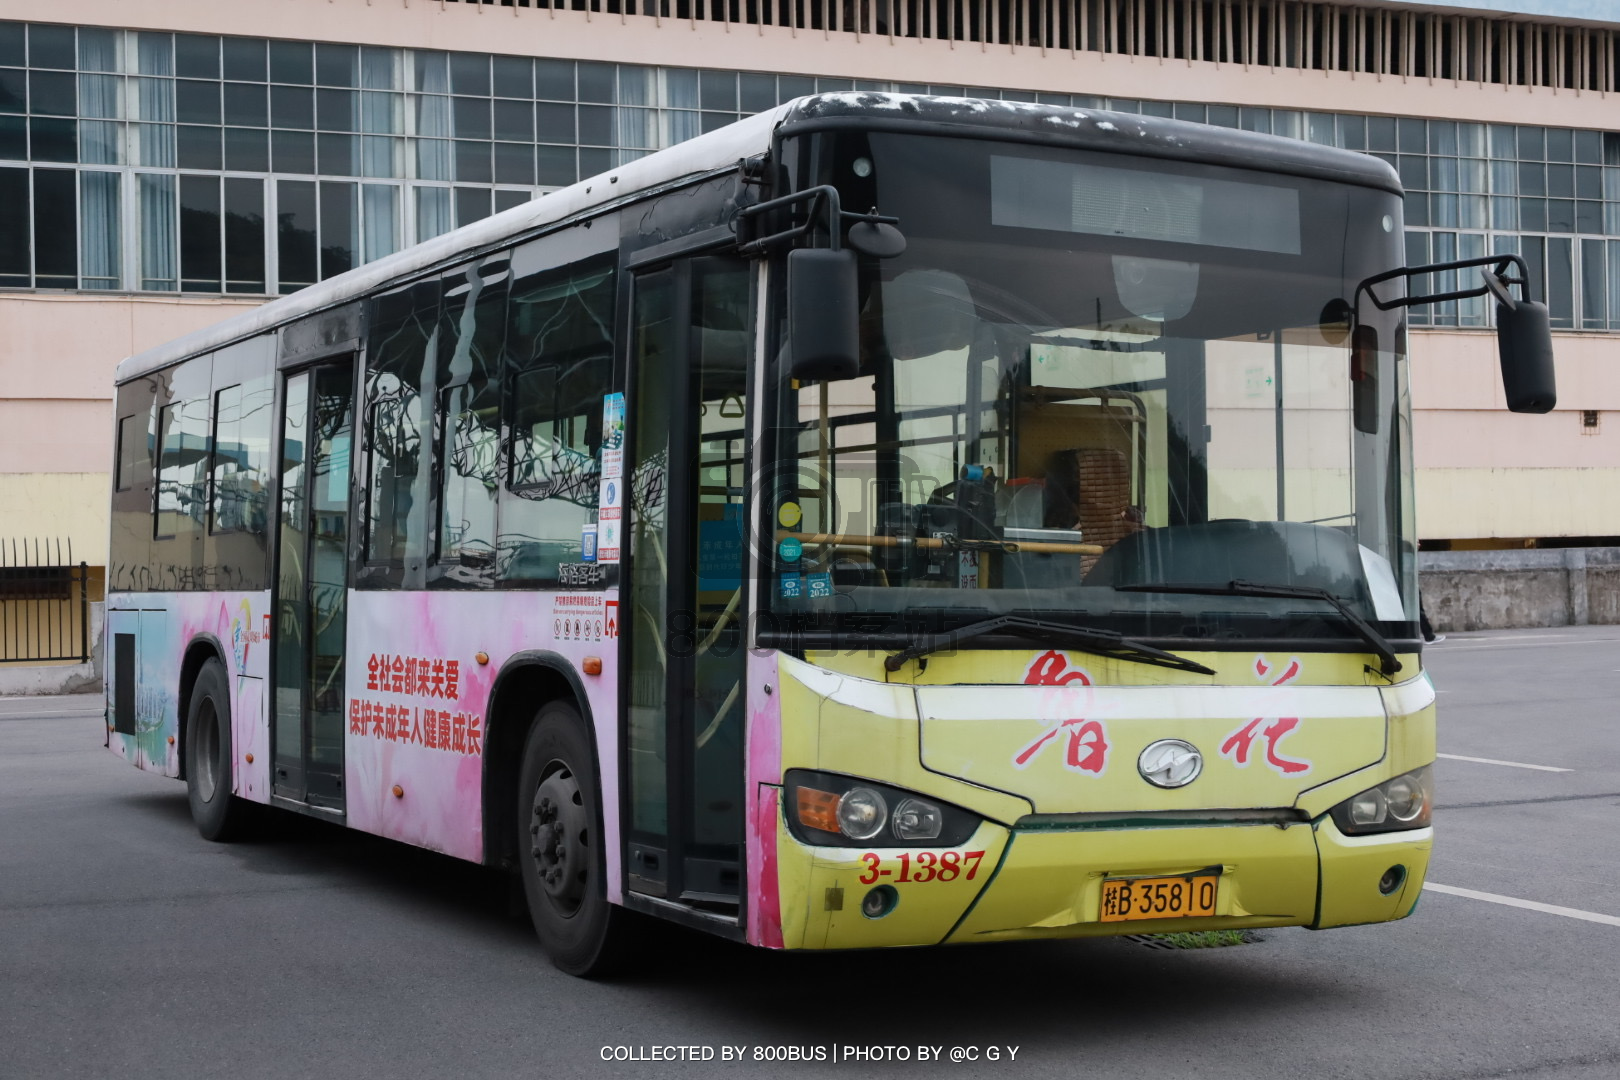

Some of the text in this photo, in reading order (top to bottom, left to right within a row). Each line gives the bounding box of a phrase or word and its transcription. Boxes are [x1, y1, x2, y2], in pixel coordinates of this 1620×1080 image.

[558, 562, 600, 585] 海格客车
[810, 588, 830, 598] 2022
[367, 653, 459, 701] 全社会都来关爱
[349, 698, 481, 756] 保护未成年人健康成长
[859, 850, 986, 885] 3-1387
